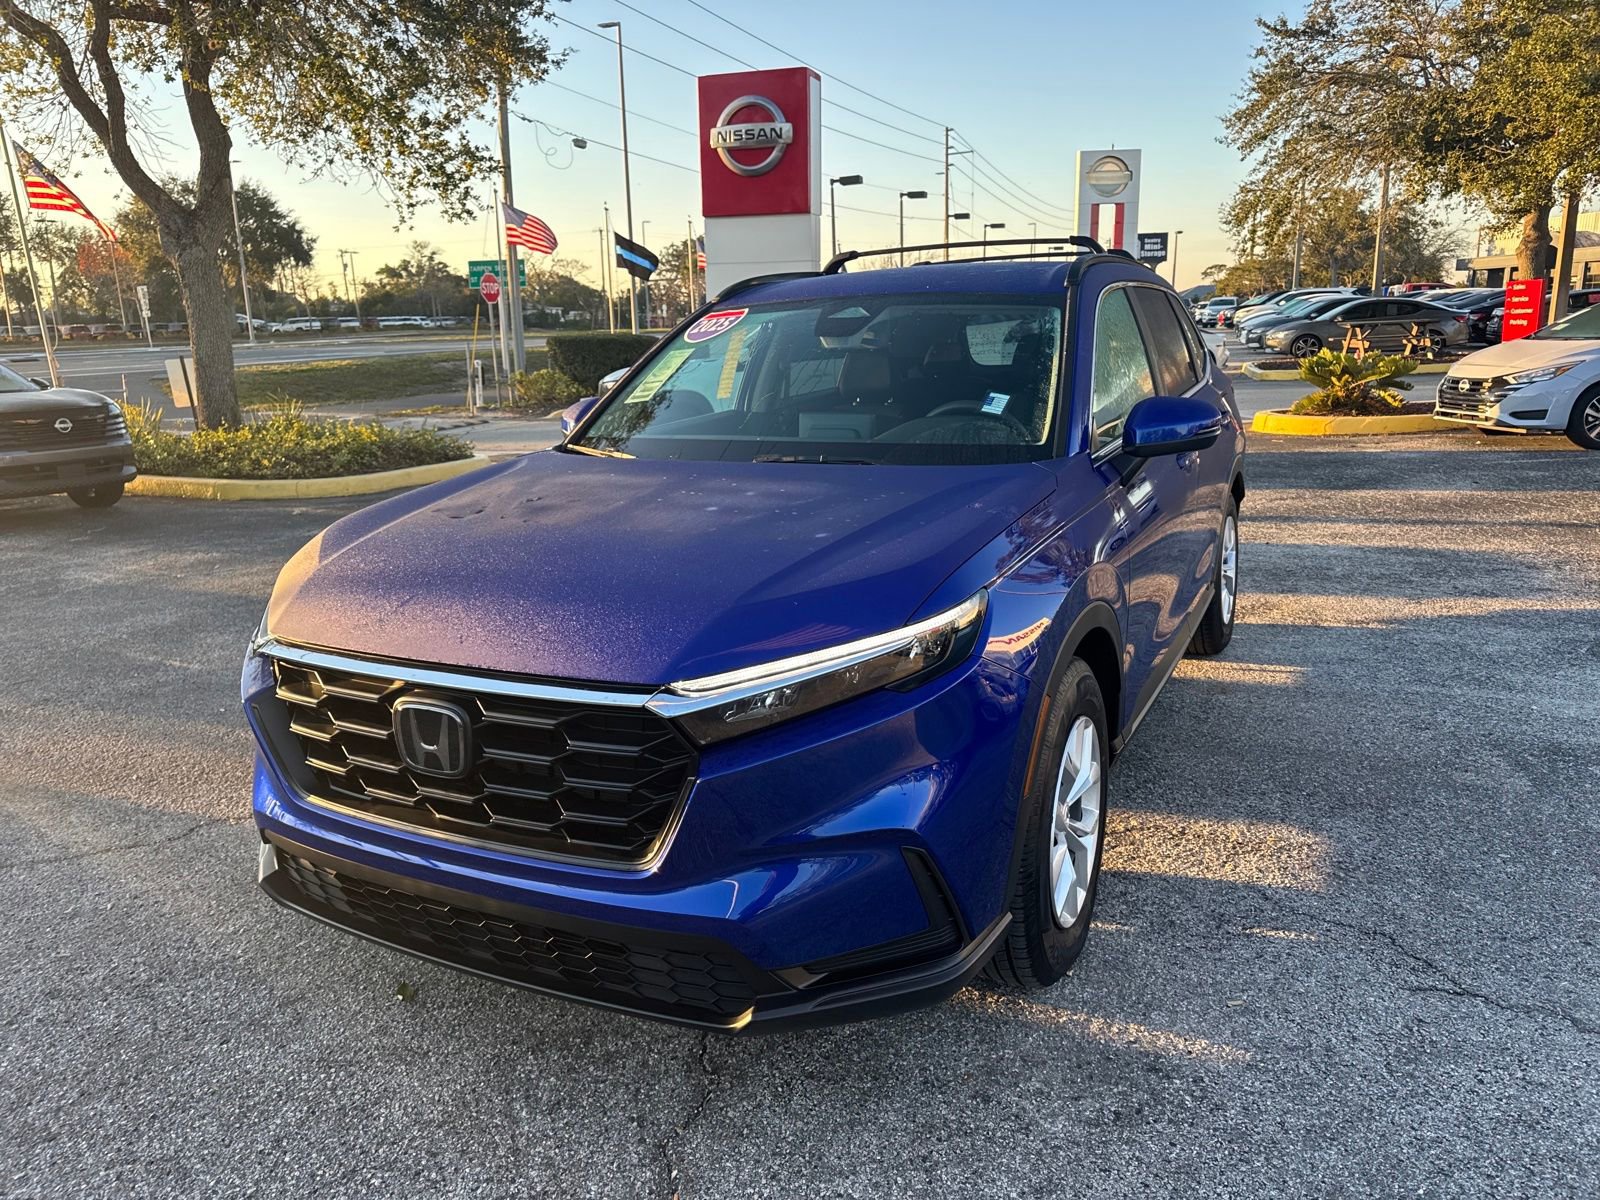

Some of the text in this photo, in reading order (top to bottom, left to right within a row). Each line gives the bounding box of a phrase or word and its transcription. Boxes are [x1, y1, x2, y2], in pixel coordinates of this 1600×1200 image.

[717, 127, 783, 143] NISSAN
[482, 282, 499, 294] STOP
[690, 316, 736, 333] 2025
